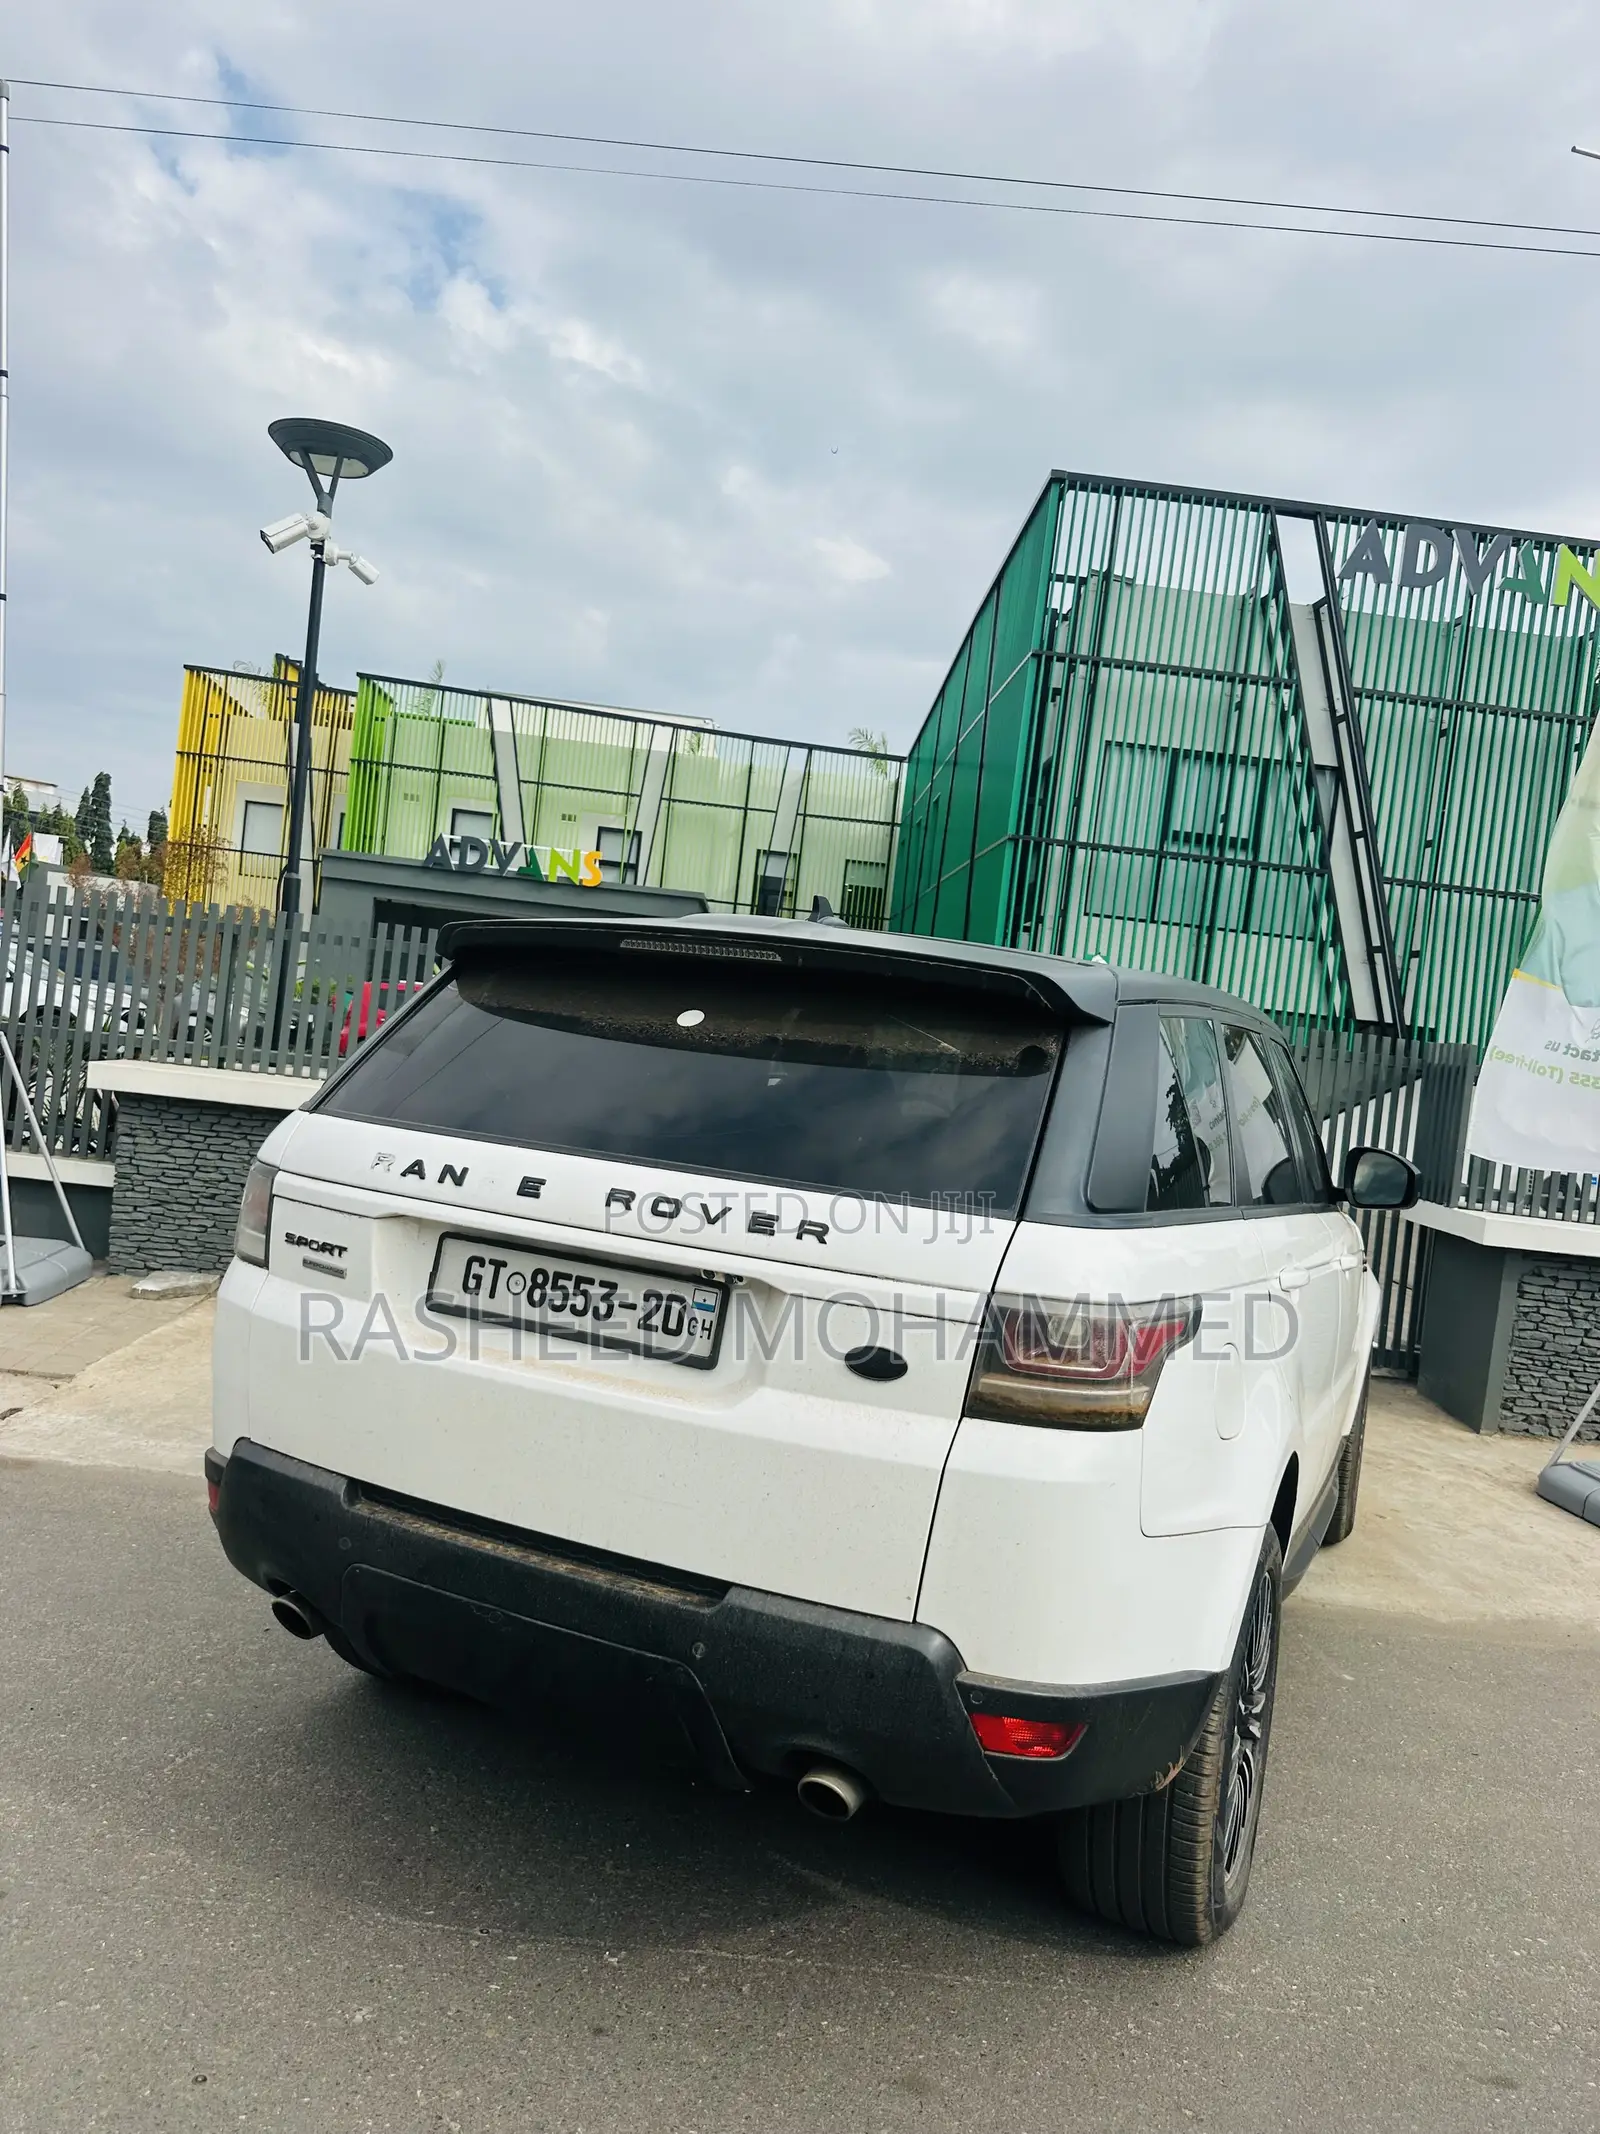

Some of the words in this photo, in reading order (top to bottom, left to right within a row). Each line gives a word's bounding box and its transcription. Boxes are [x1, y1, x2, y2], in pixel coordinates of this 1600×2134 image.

[422, 832, 603, 888] ADVANS
[604, 1187, 830, 1244] ROVER
[285, 1232, 348, 1258] SPORT
[462, 1255, 508, 1299] GT
[687, 1316, 714, 1340] GH
